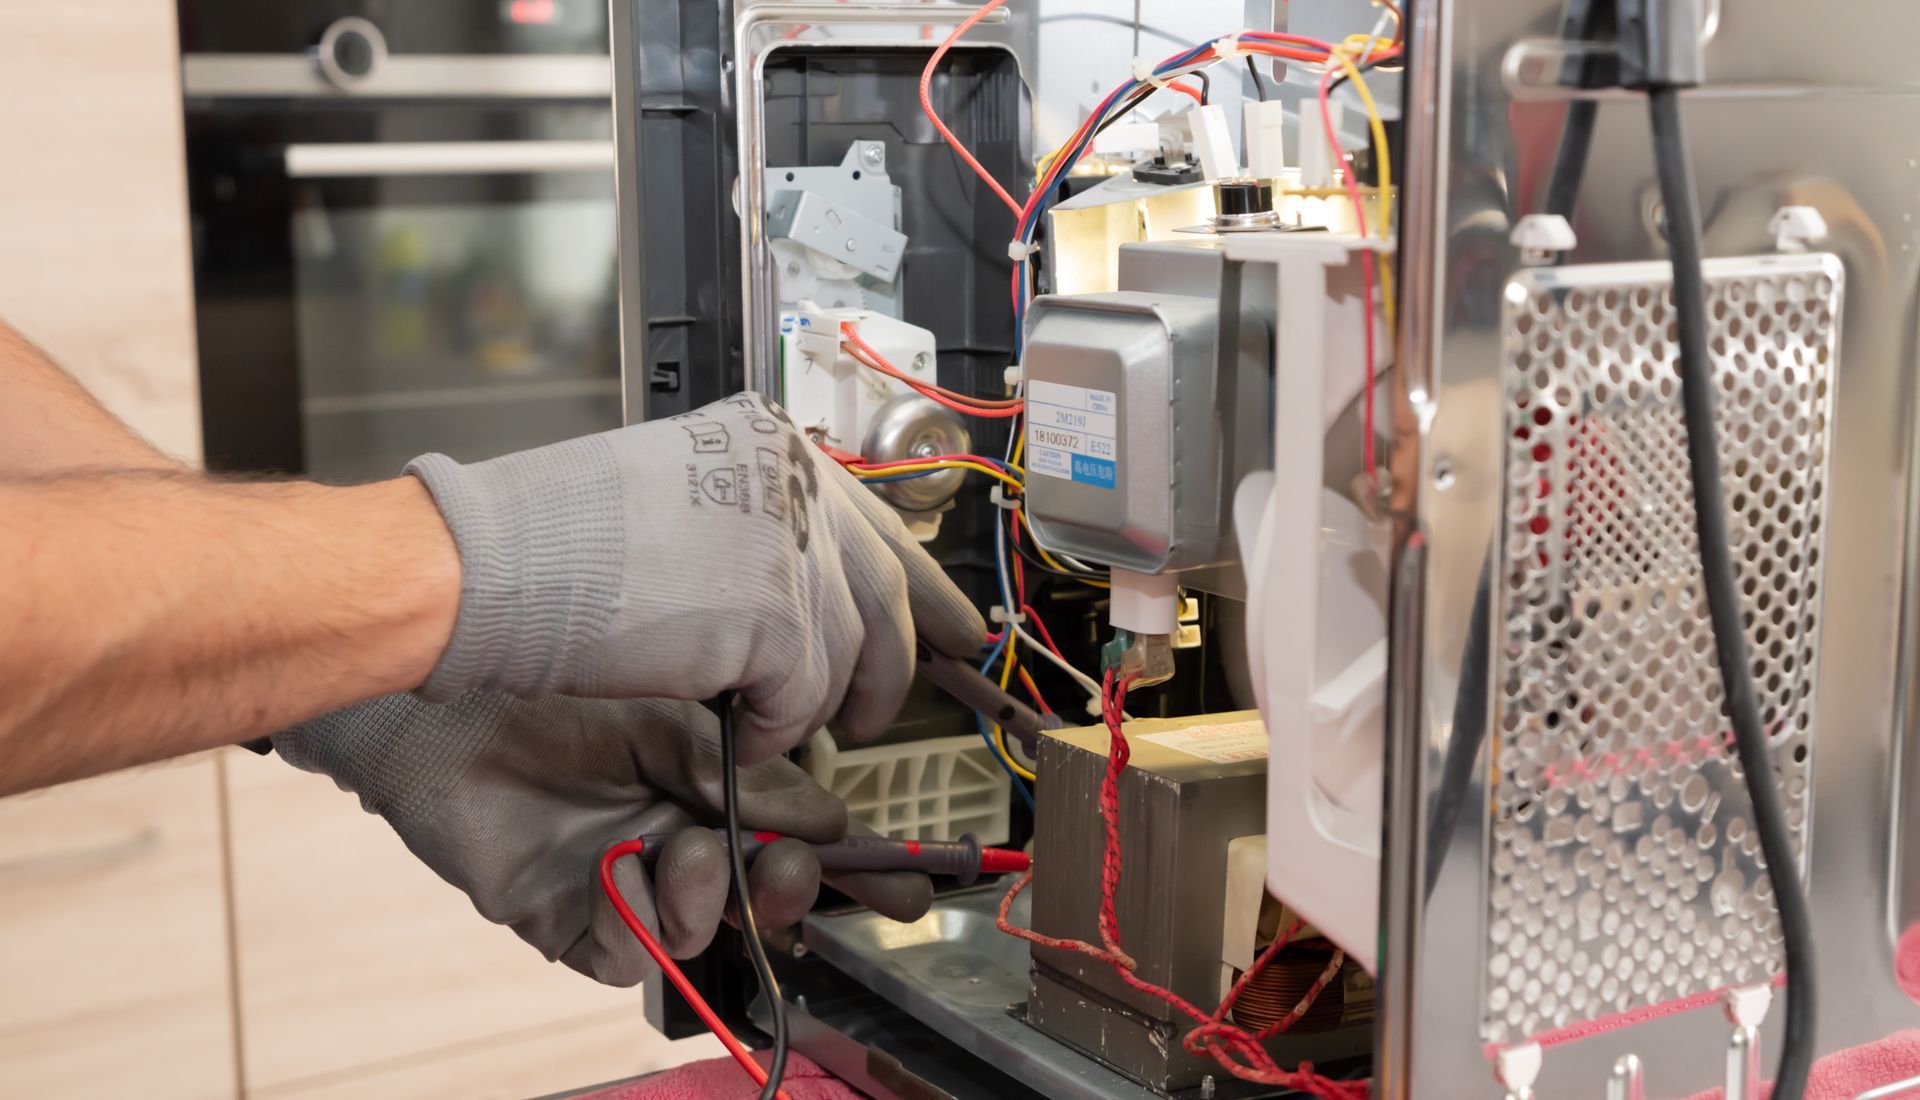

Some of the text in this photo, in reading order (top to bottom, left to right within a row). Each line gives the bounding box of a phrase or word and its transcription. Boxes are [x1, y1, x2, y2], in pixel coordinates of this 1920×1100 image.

[1034, 429, 1080, 449] 18100372
[1090, 441, 1112, 455] E522
[686, 463, 702, 506] 3121X
[736, 463, 751, 513] EN388
